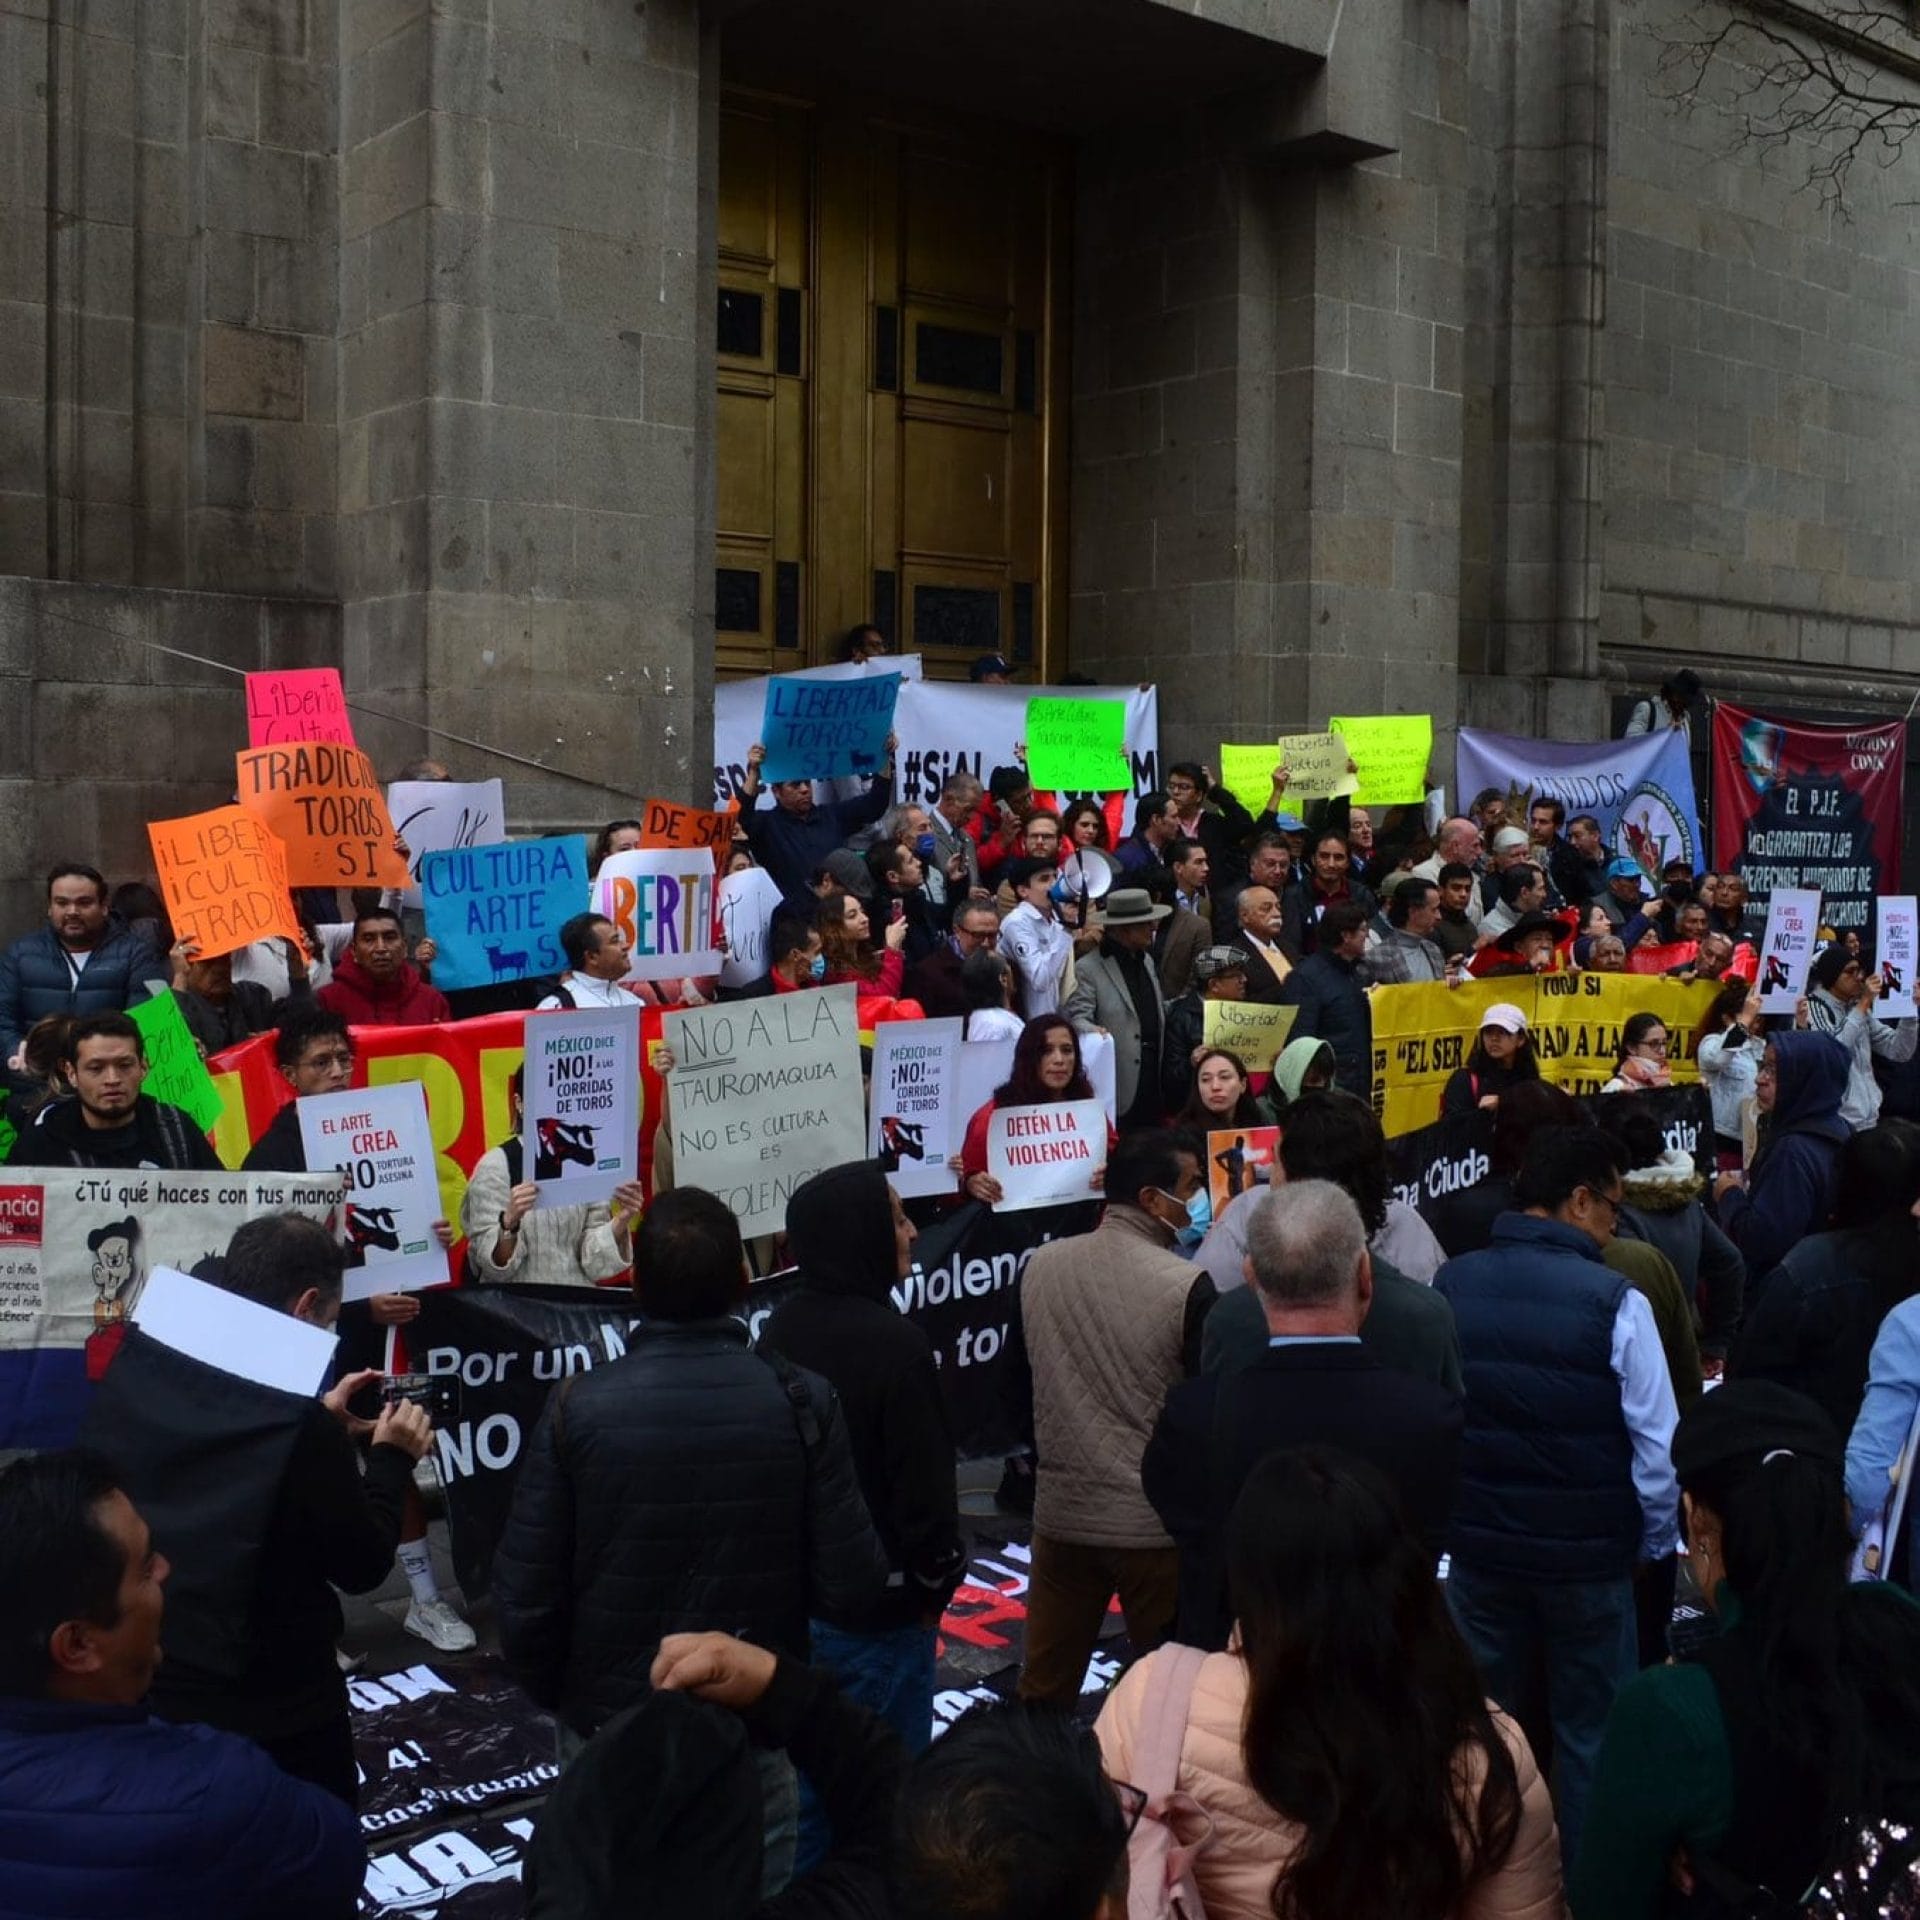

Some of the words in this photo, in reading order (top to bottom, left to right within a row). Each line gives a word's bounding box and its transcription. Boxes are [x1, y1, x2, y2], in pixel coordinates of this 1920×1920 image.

[773, 681, 899, 719] LIBERTAD
[786, 720, 868, 748] TOROS
[803, 750, 840, 777] SI
[1785, 787, 1800, 815] EL
[294, 795, 384, 837] TOROS
[648, 806, 686, 839] DE
[337, 841, 378, 879] SI
[427, 844, 574, 898] CULTURA
[467, 890, 546, 936] ARTE
[1774, 932, 1791, 951] NO
[680, 1016, 734, 1063] NO
[747, 1008, 772, 1046] A
[783, 996, 840, 1042] LA
[544, 1035, 593, 1055] MÉXICO
[594, 1036, 616, 1049] DICE
[890, 1044, 926, 1060] MÉXICO
[1432, 1036, 1464, 1071] SER
[1574, 1023, 1589, 1057] A
[548, 1055, 593, 1088] ¡NO!
[672, 1061, 838, 1110] TAUROMAQUIA
[891, 1061, 926, 1090] ¡NO!
[557, 1079, 613, 1098] CORRIDAS
[897, 1083, 940, 1099] CORRIDAS
[556, 1098, 573, 1114] DE
[576, 1094, 613, 1112] TOROS
[896, 1100, 908, 1114] DE
[911, 1098, 940, 1111] TOROS
[322, 1119, 337, 1135] EL
[341, 1113, 373, 1132] ARTE
[679, 1129, 718, 1158] NO
[725, 1121, 752, 1145] ES
[763, 1109, 830, 1138] CULTURA
[1006, 1108, 1052, 1138] DETÉN
[1056, 1112, 1077, 1132] LA
[351, 1129, 399, 1155] CREA
[760, 1143, 782, 1161] ES
[1006, 1138, 1091, 1167] VIOLENCIA
[335, 1158, 376, 1191] NO
[375, 1156, 416, 1171] TORTURA
[378, 1169, 415, 1185] ASESINA
[75, 1179, 111, 1202] ¿Tú
[119, 1180, 149, 1208] qué
[158, 1181, 209, 1205] haces
[217, 1188, 247, 1205] con
[256, 1185, 284, 1205] tus
[427, 1345, 519, 1388] Por
[532, 1343, 593, 1381] un
